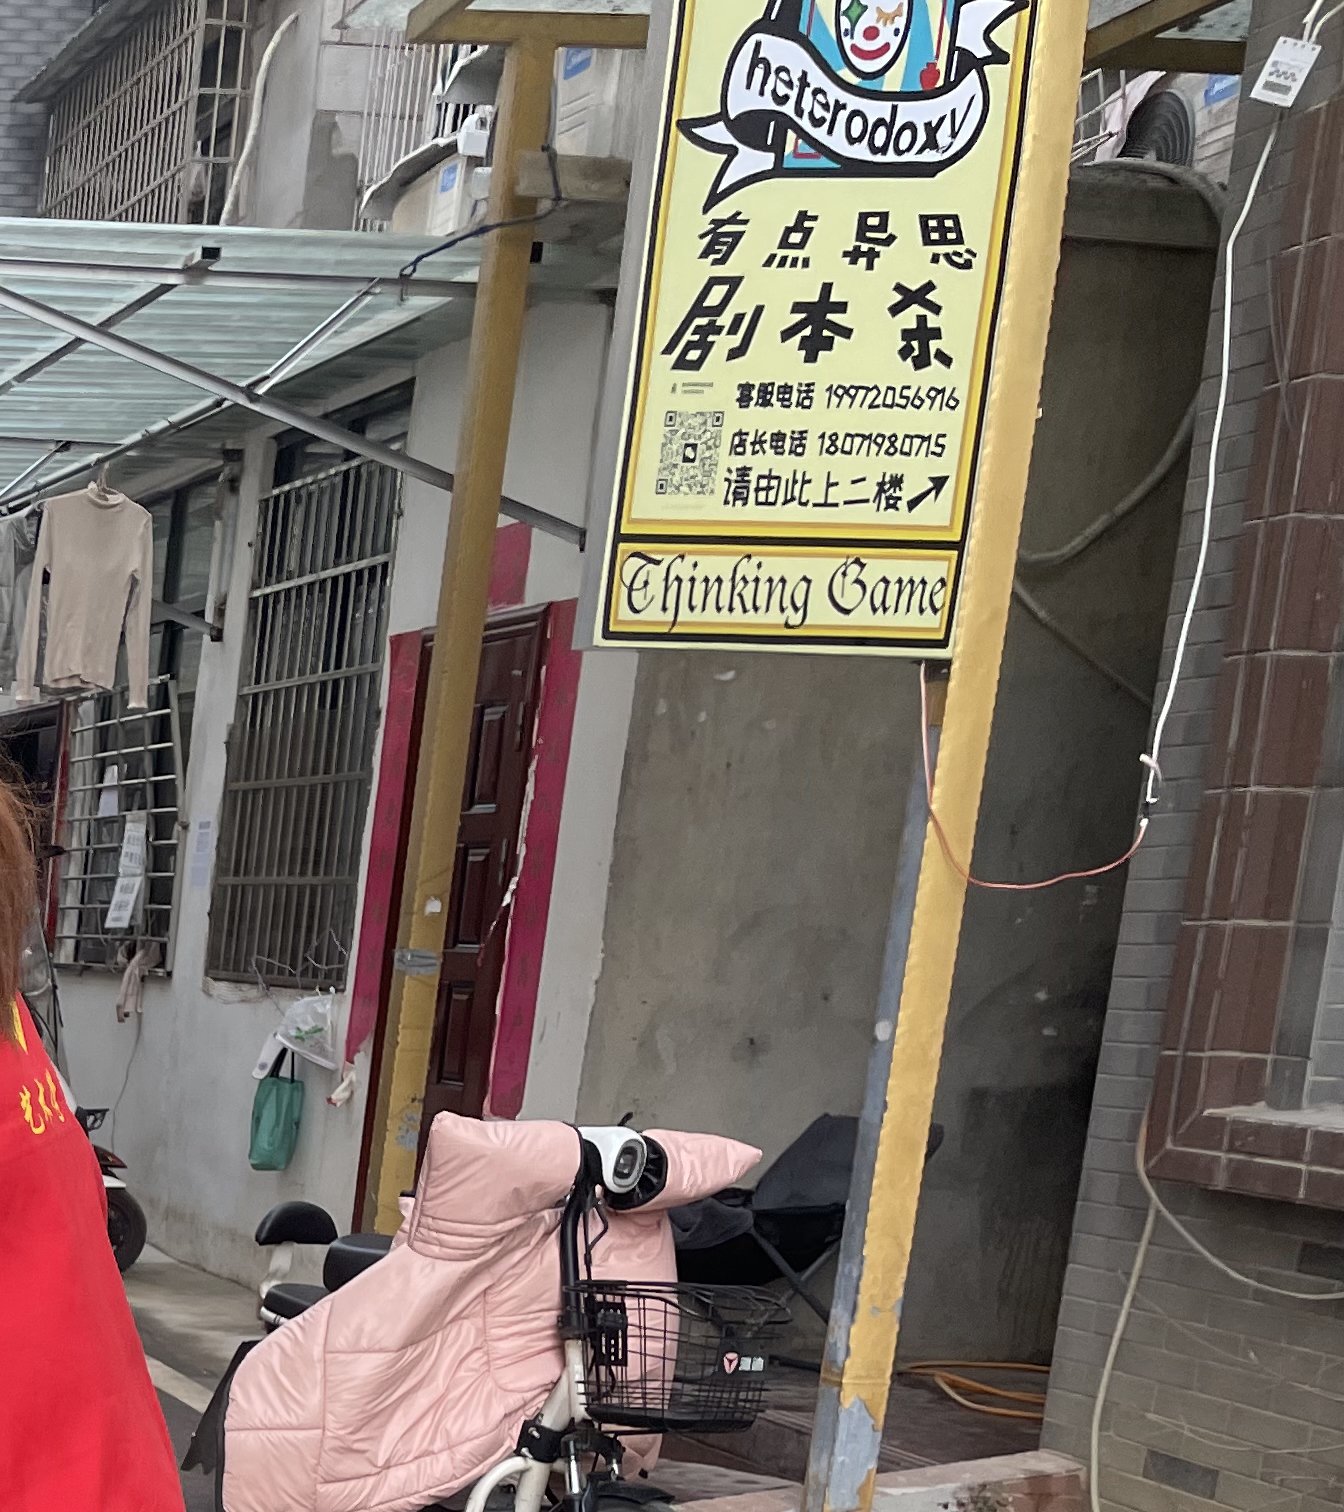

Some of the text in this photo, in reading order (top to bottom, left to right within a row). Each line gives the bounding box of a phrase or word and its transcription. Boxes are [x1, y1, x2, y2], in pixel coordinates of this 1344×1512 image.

[745, 39, 976, 157] heterodoxy
[697, 210, 977, 271] 有点异思
[660, 275, 953, 372] 剧本杀
[735, 381, 816, 410] 客服电话
[824, 383, 961, 411] 19972056916
[728, 428, 947, 458] 店长电话 18071980715
[723, 466, 905, 513] 请由此上二楼
[619, 551, 947, 633] Thinking Game
